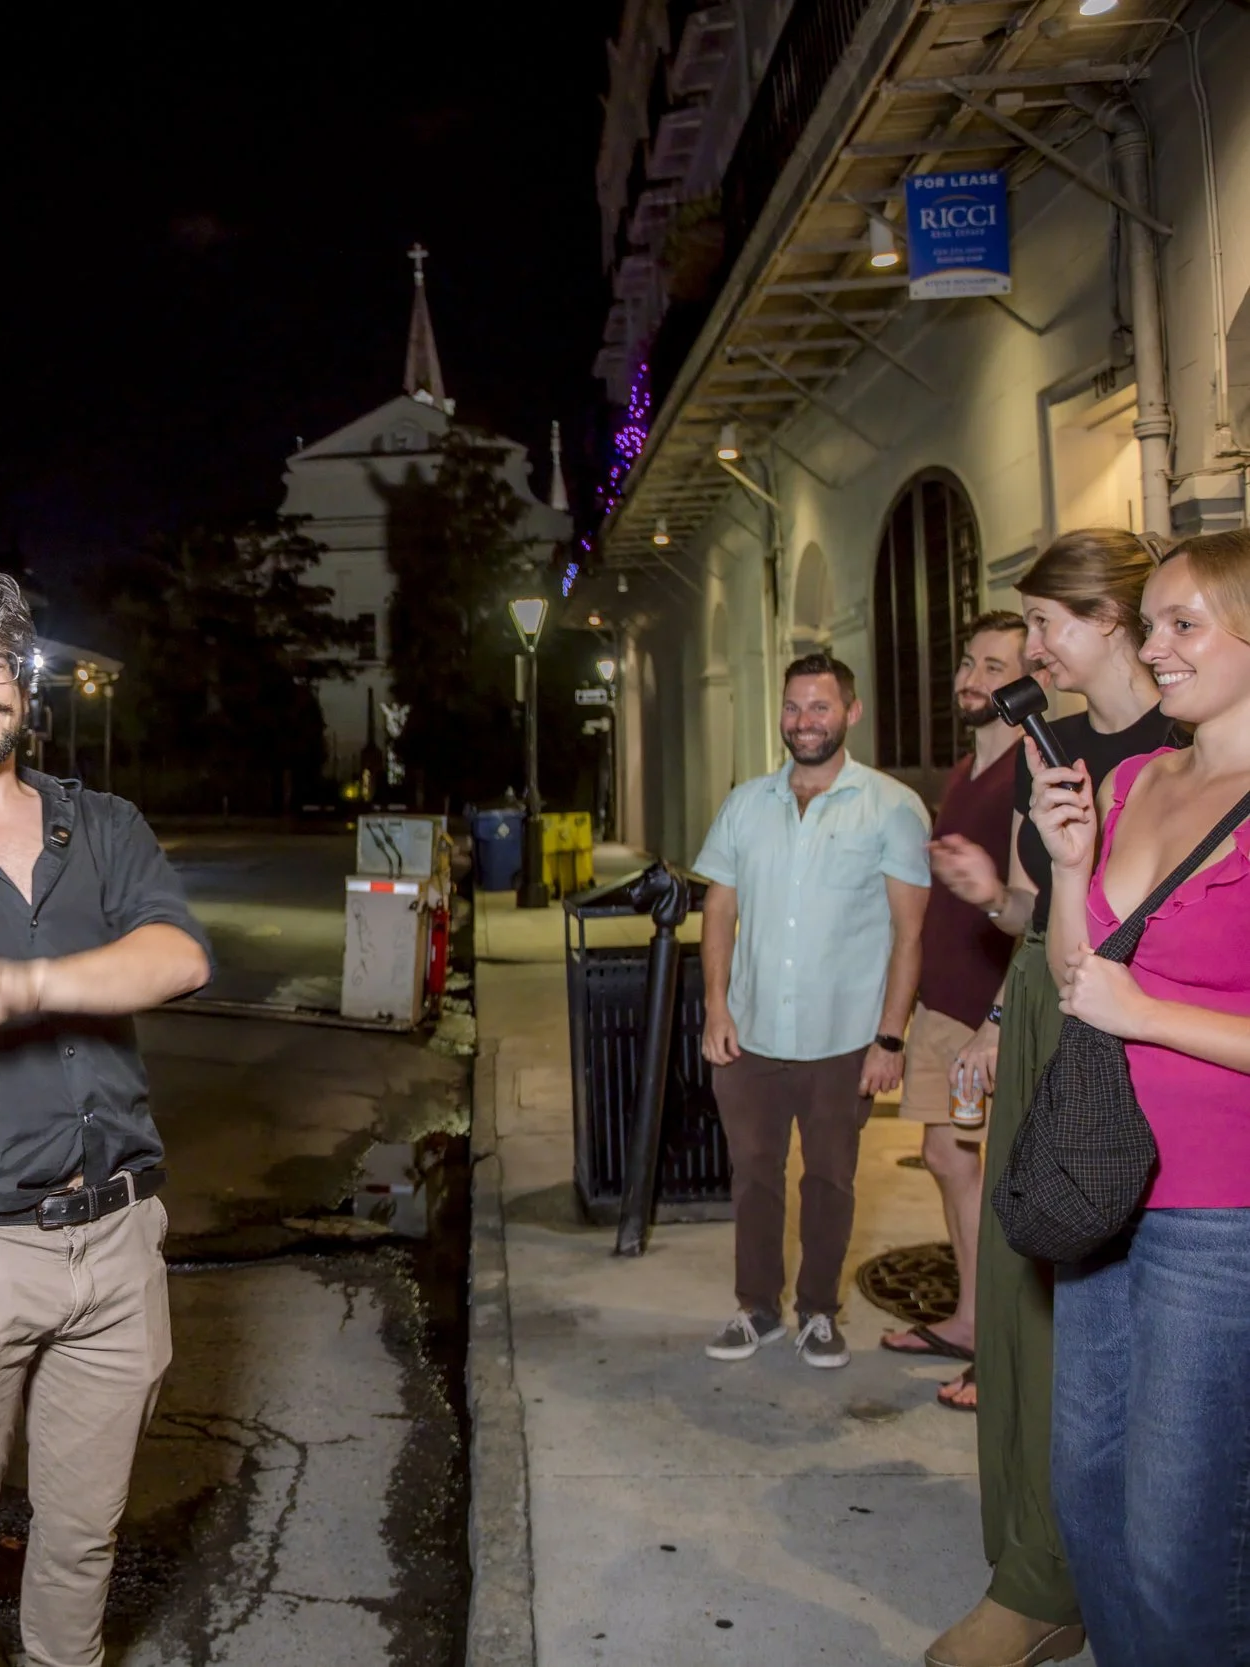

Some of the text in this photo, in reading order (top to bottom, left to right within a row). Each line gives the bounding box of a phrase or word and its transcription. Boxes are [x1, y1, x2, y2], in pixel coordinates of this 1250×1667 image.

[914, 174, 998, 190] FOR LEASE
[919, 204, 997, 230] RICCI
